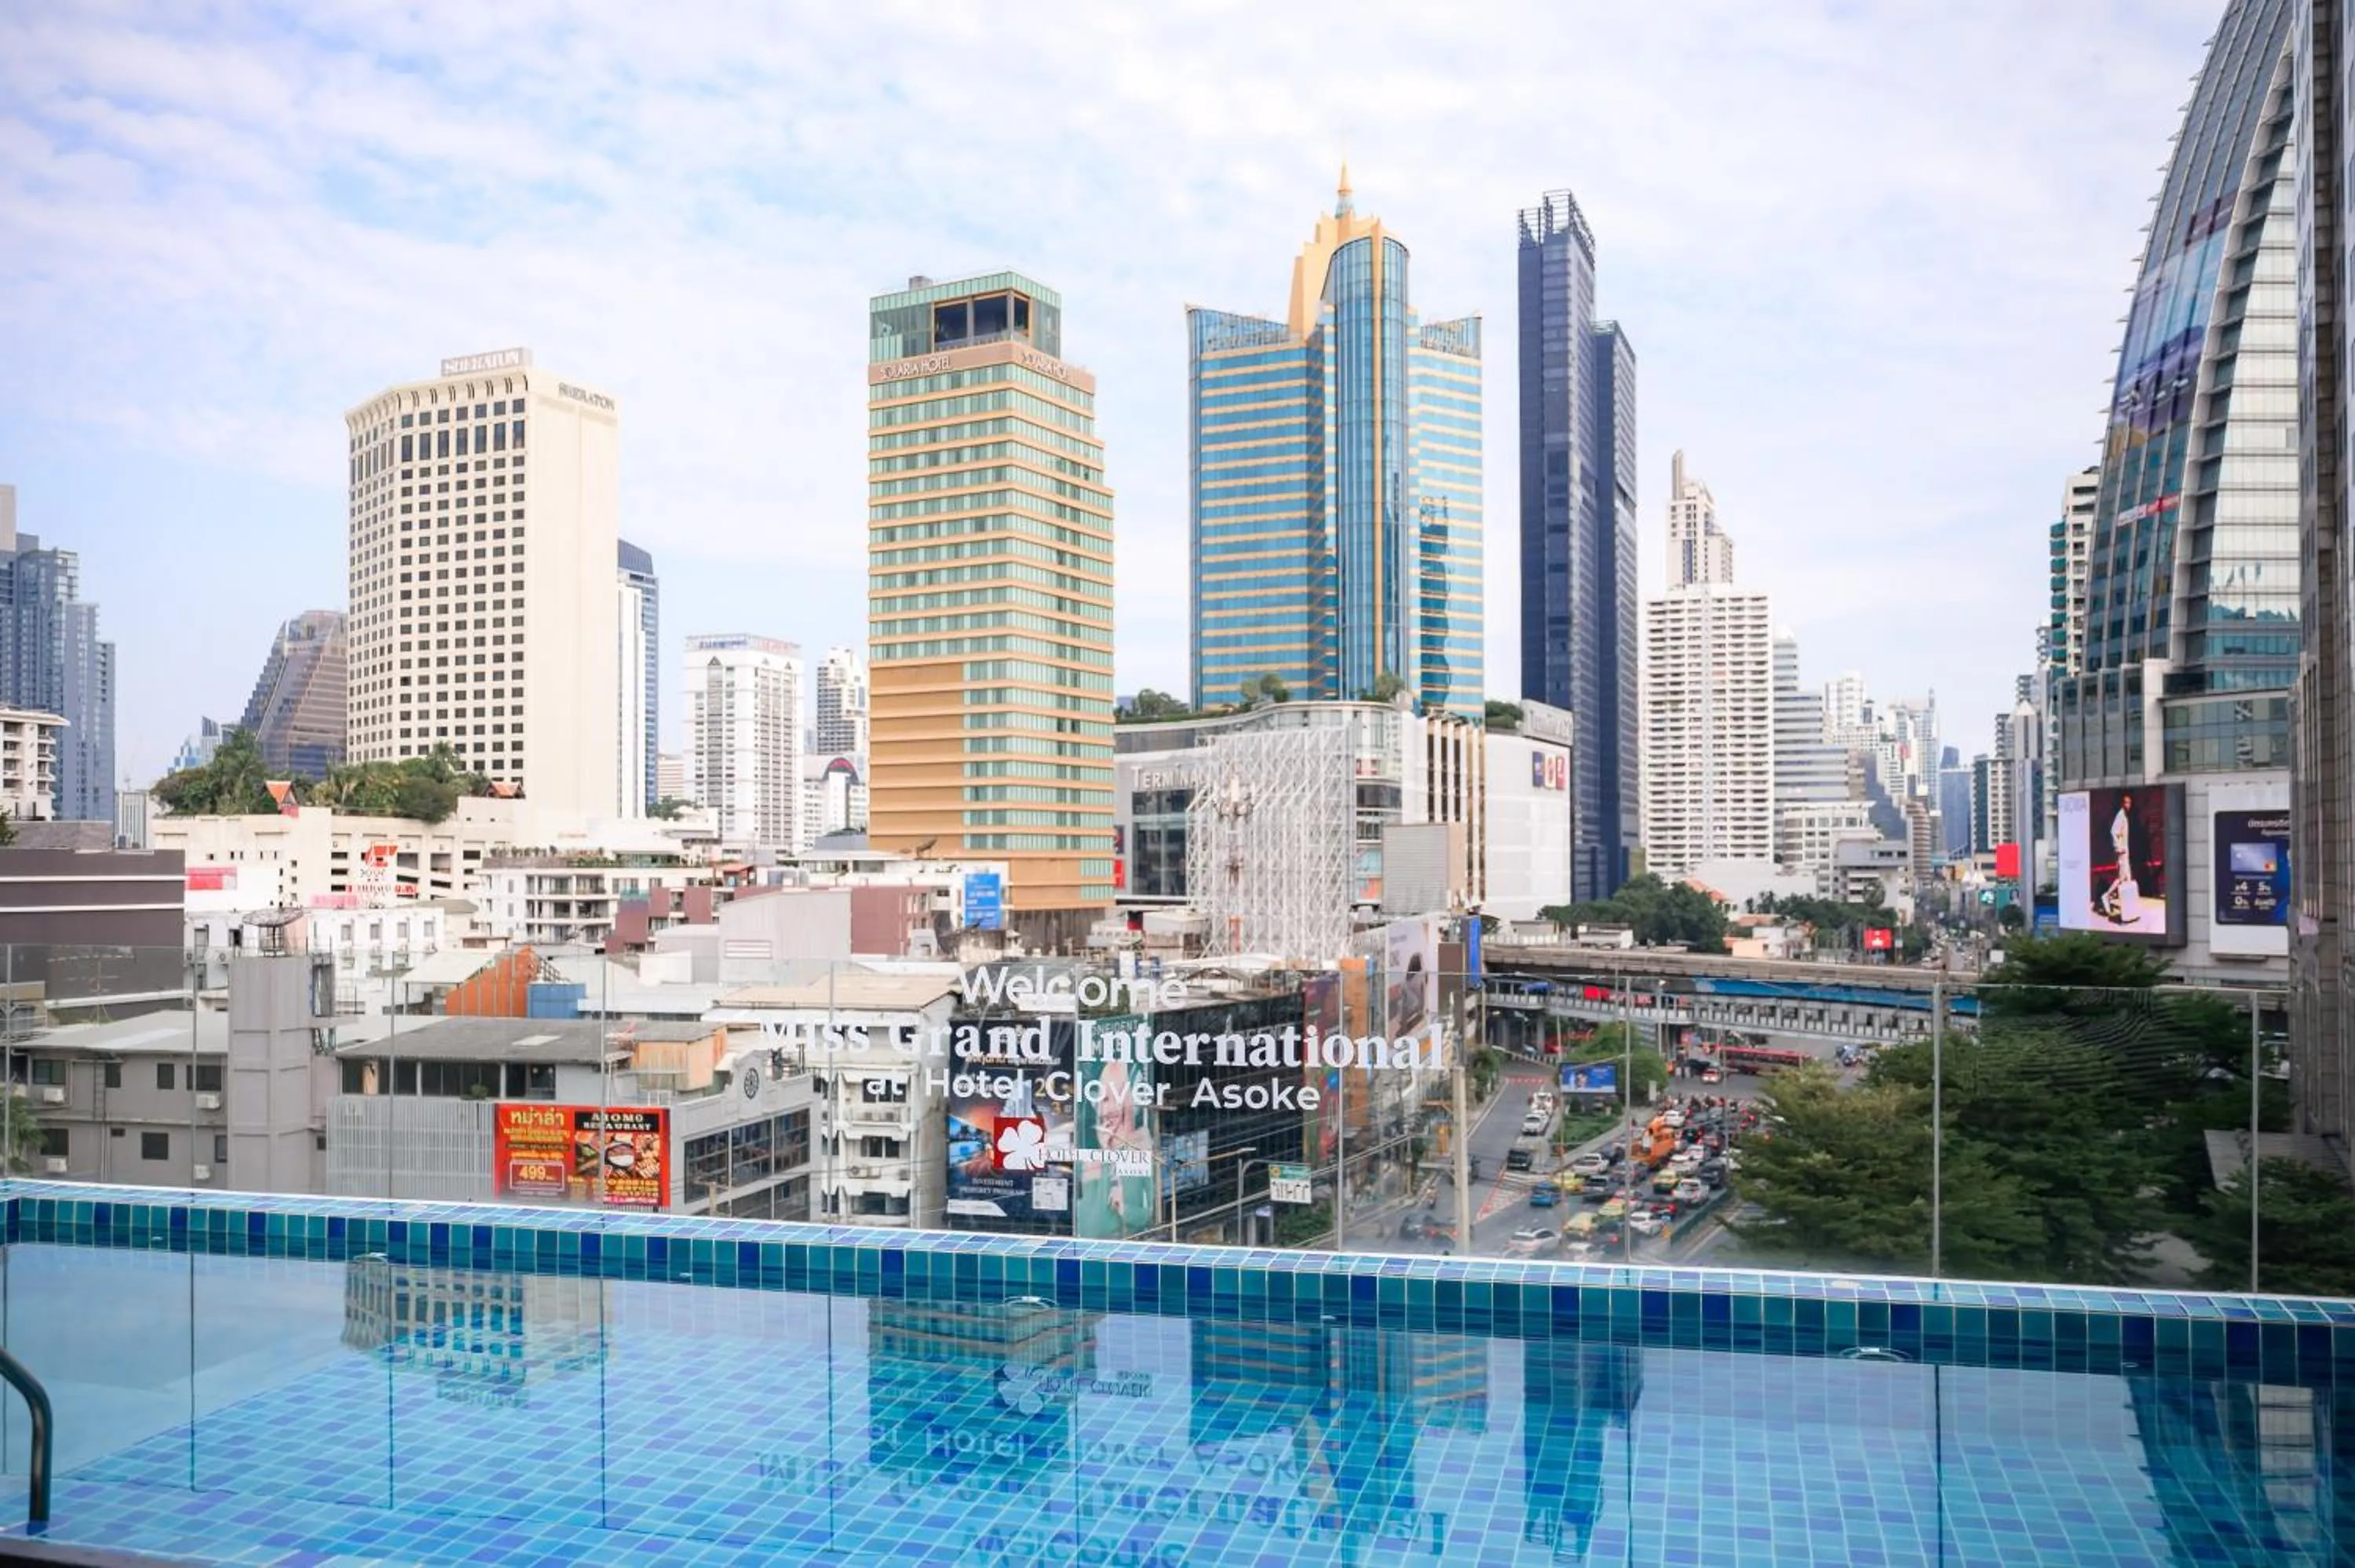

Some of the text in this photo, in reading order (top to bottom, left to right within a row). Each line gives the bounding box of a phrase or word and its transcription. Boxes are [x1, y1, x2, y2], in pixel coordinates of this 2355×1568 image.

[955, 965, 1188, 1009] Welcome
[761, 1017, 871, 1053] Miss
[888, 1015, 1061, 1062] Grand
[1076, 1019, 1445, 1070] International
[866, 1069, 904, 1096] at
[926, 1067, 1024, 1099] Hotel
[1045, 1070, 1170, 1107] Clover
[1190, 1077, 1320, 1110] Asoke
[583, 1121, 652, 1131] REAURANT
[1090, 1149, 1149, 1163] CLOVER
[519, 1165, 546, 1180] 499
